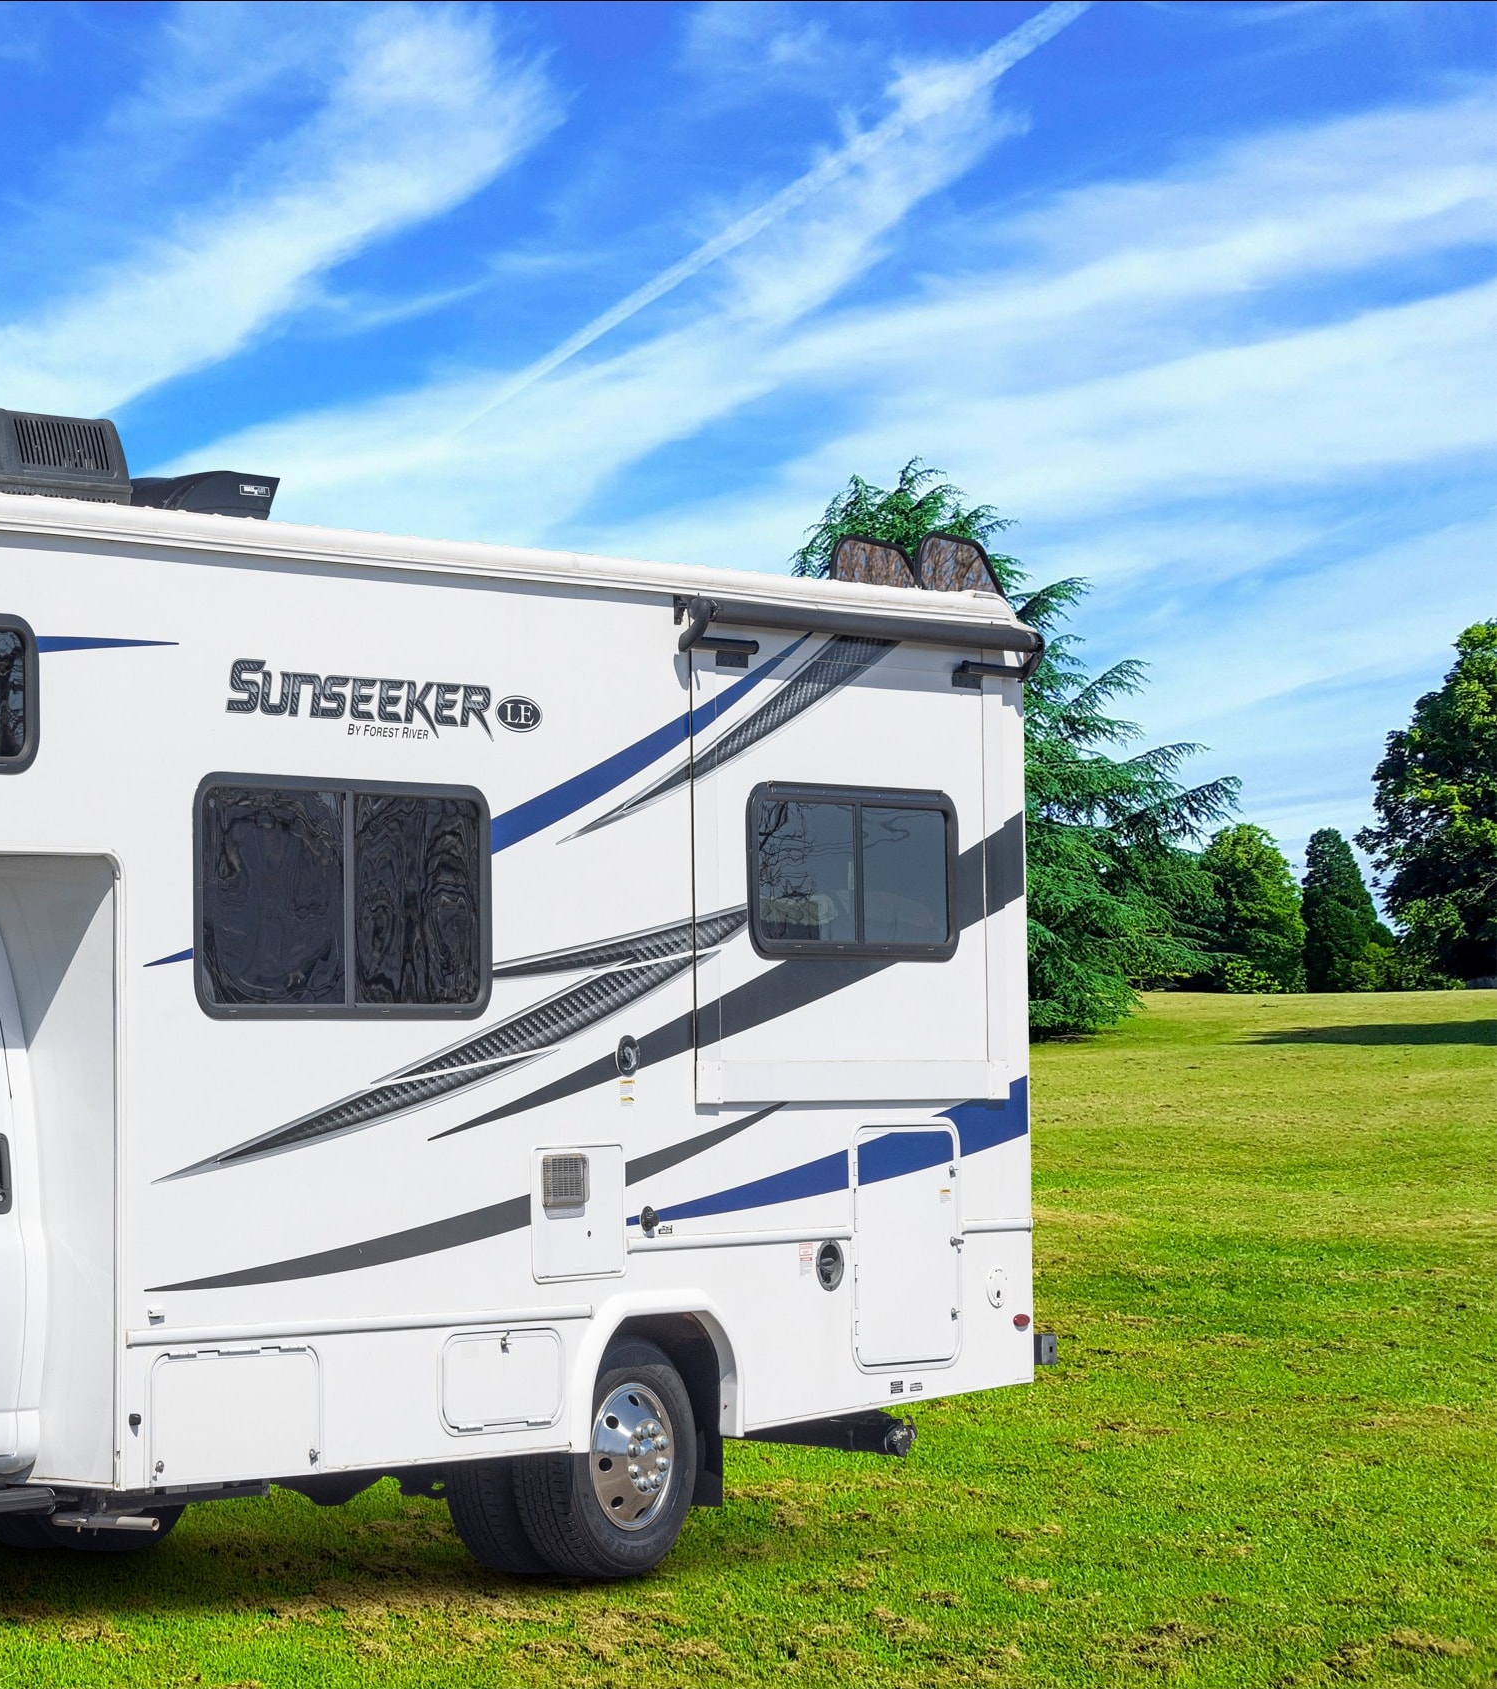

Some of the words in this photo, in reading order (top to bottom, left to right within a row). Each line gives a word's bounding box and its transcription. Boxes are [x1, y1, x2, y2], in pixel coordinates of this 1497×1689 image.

[225, 658, 494, 742] SUNSEEKER
[504, 704, 534, 726] LE
[347, 723, 361, 735] BY
[363, 724, 400, 738] FOREST
[401, 726, 429, 740] RIVER
